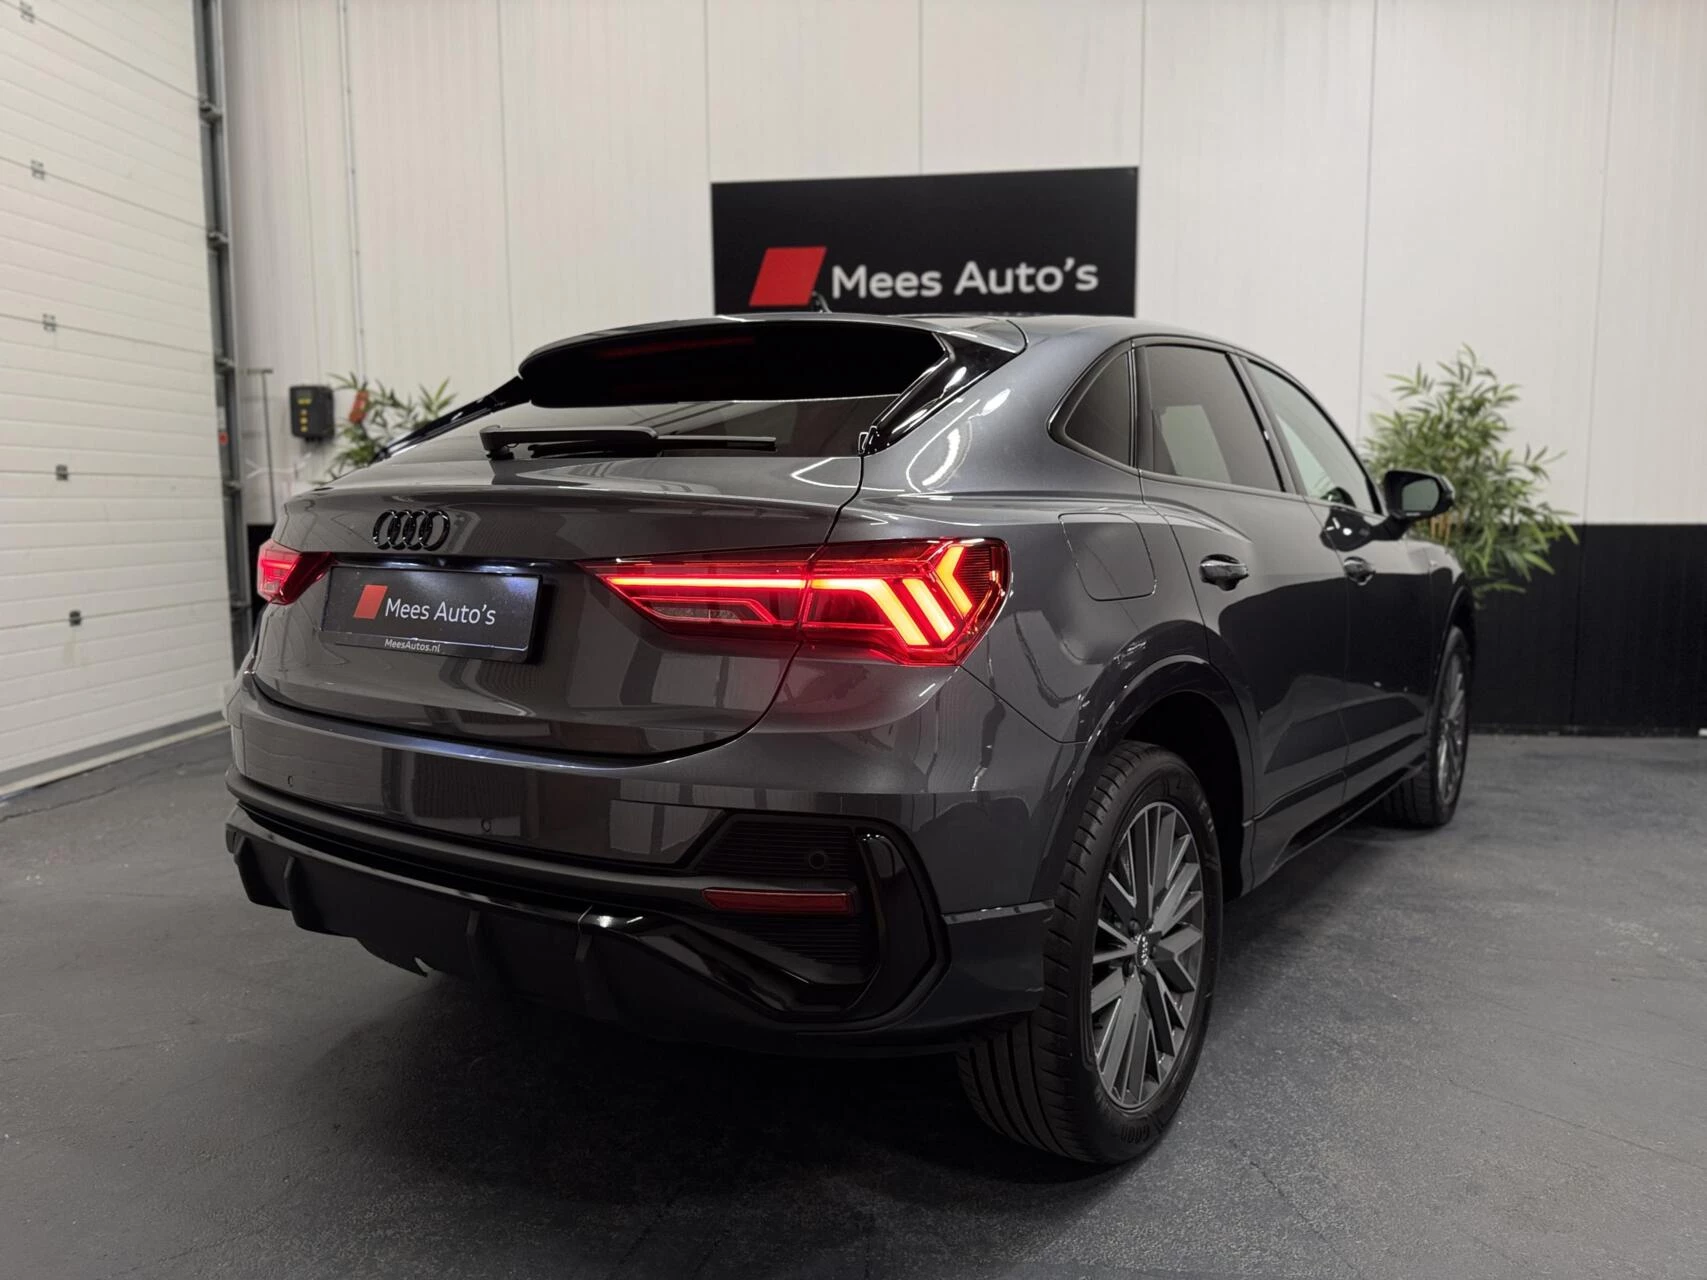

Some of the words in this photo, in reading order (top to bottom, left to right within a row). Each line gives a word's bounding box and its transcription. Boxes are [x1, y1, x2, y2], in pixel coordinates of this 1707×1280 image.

[831, 264, 943, 299] Mees
[953, 257, 1099, 296] Auto's
[385, 598, 430, 620] Mees
[433, 601, 496, 625] Auto's
[384, 638, 441, 653] MeesAutos.nl
